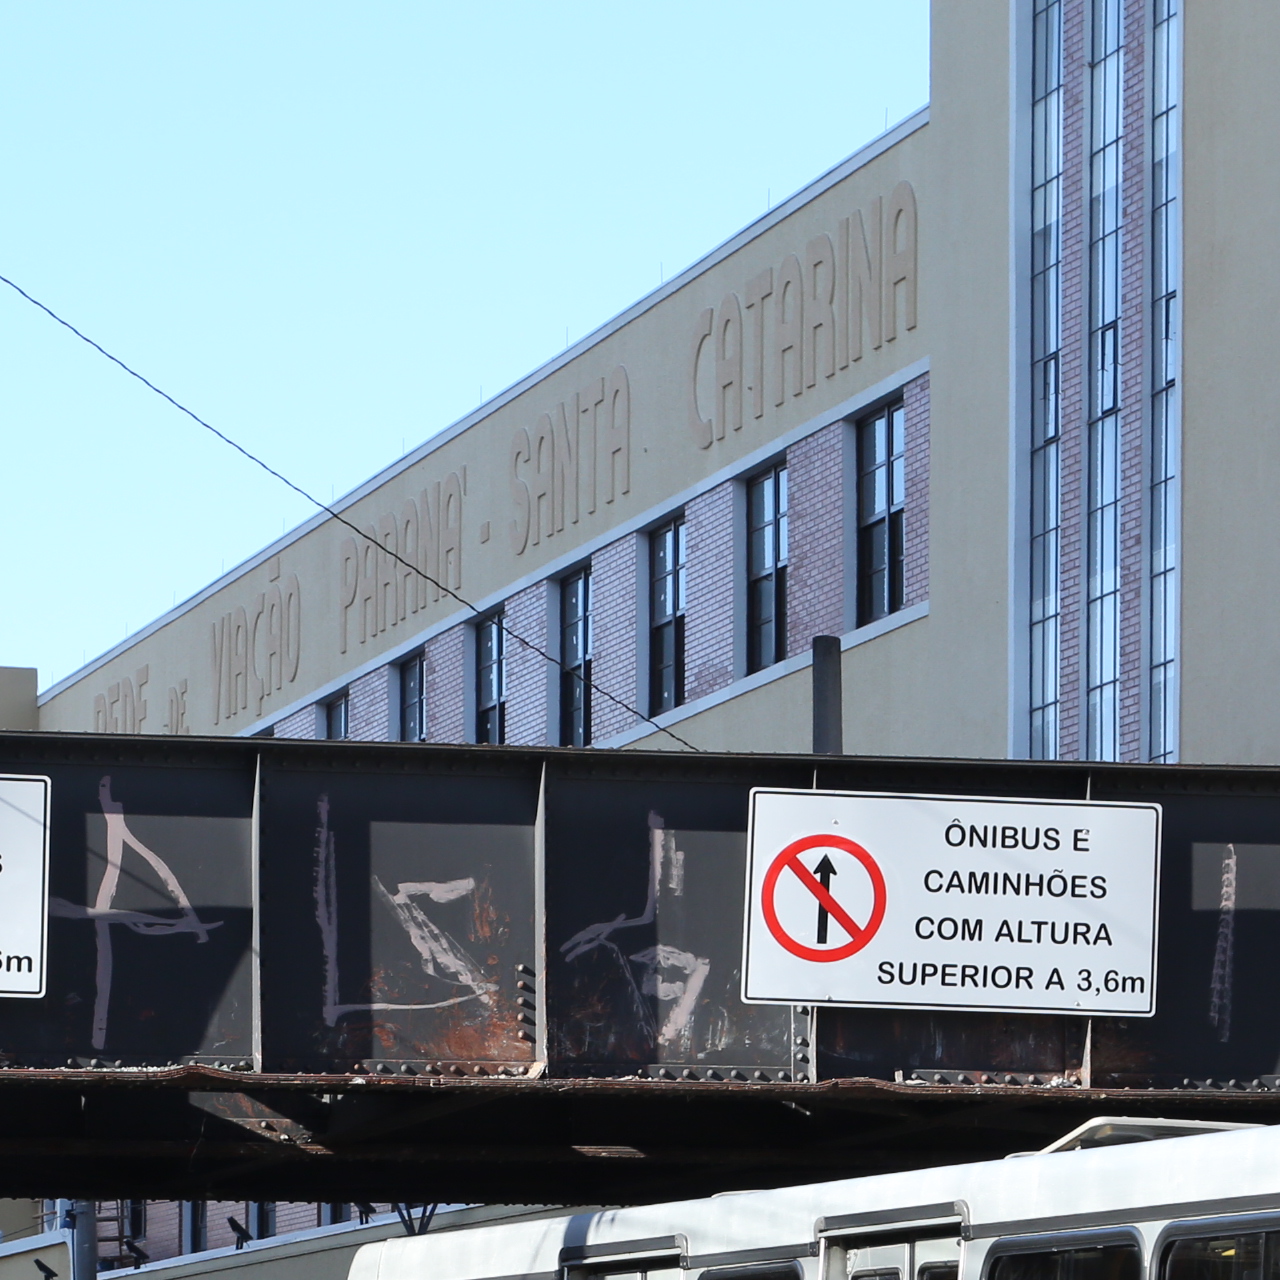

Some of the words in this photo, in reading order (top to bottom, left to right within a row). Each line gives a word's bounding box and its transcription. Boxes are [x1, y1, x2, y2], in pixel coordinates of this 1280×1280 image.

[212, 556, 301, 725] VIAÇÃO
[340, 464, 468, 655] PARANÁ
[509, 363, 631, 557] SANTA
[693, 179, 919, 450] CATARINA
[944, 818, 1061, 853] ÔNIBUS
[1072, 827, 1091, 853] E
[923, 868, 1108, 900] CAMINHÕES
[915, 916, 983, 944] COM
[995, 920, 1114, 948] ALTURA
[877, 959, 1034, 991] SUPERIOR
[1044, 963, 1066, 992] A
[1076, 966, 1146, 995] 3,6m
